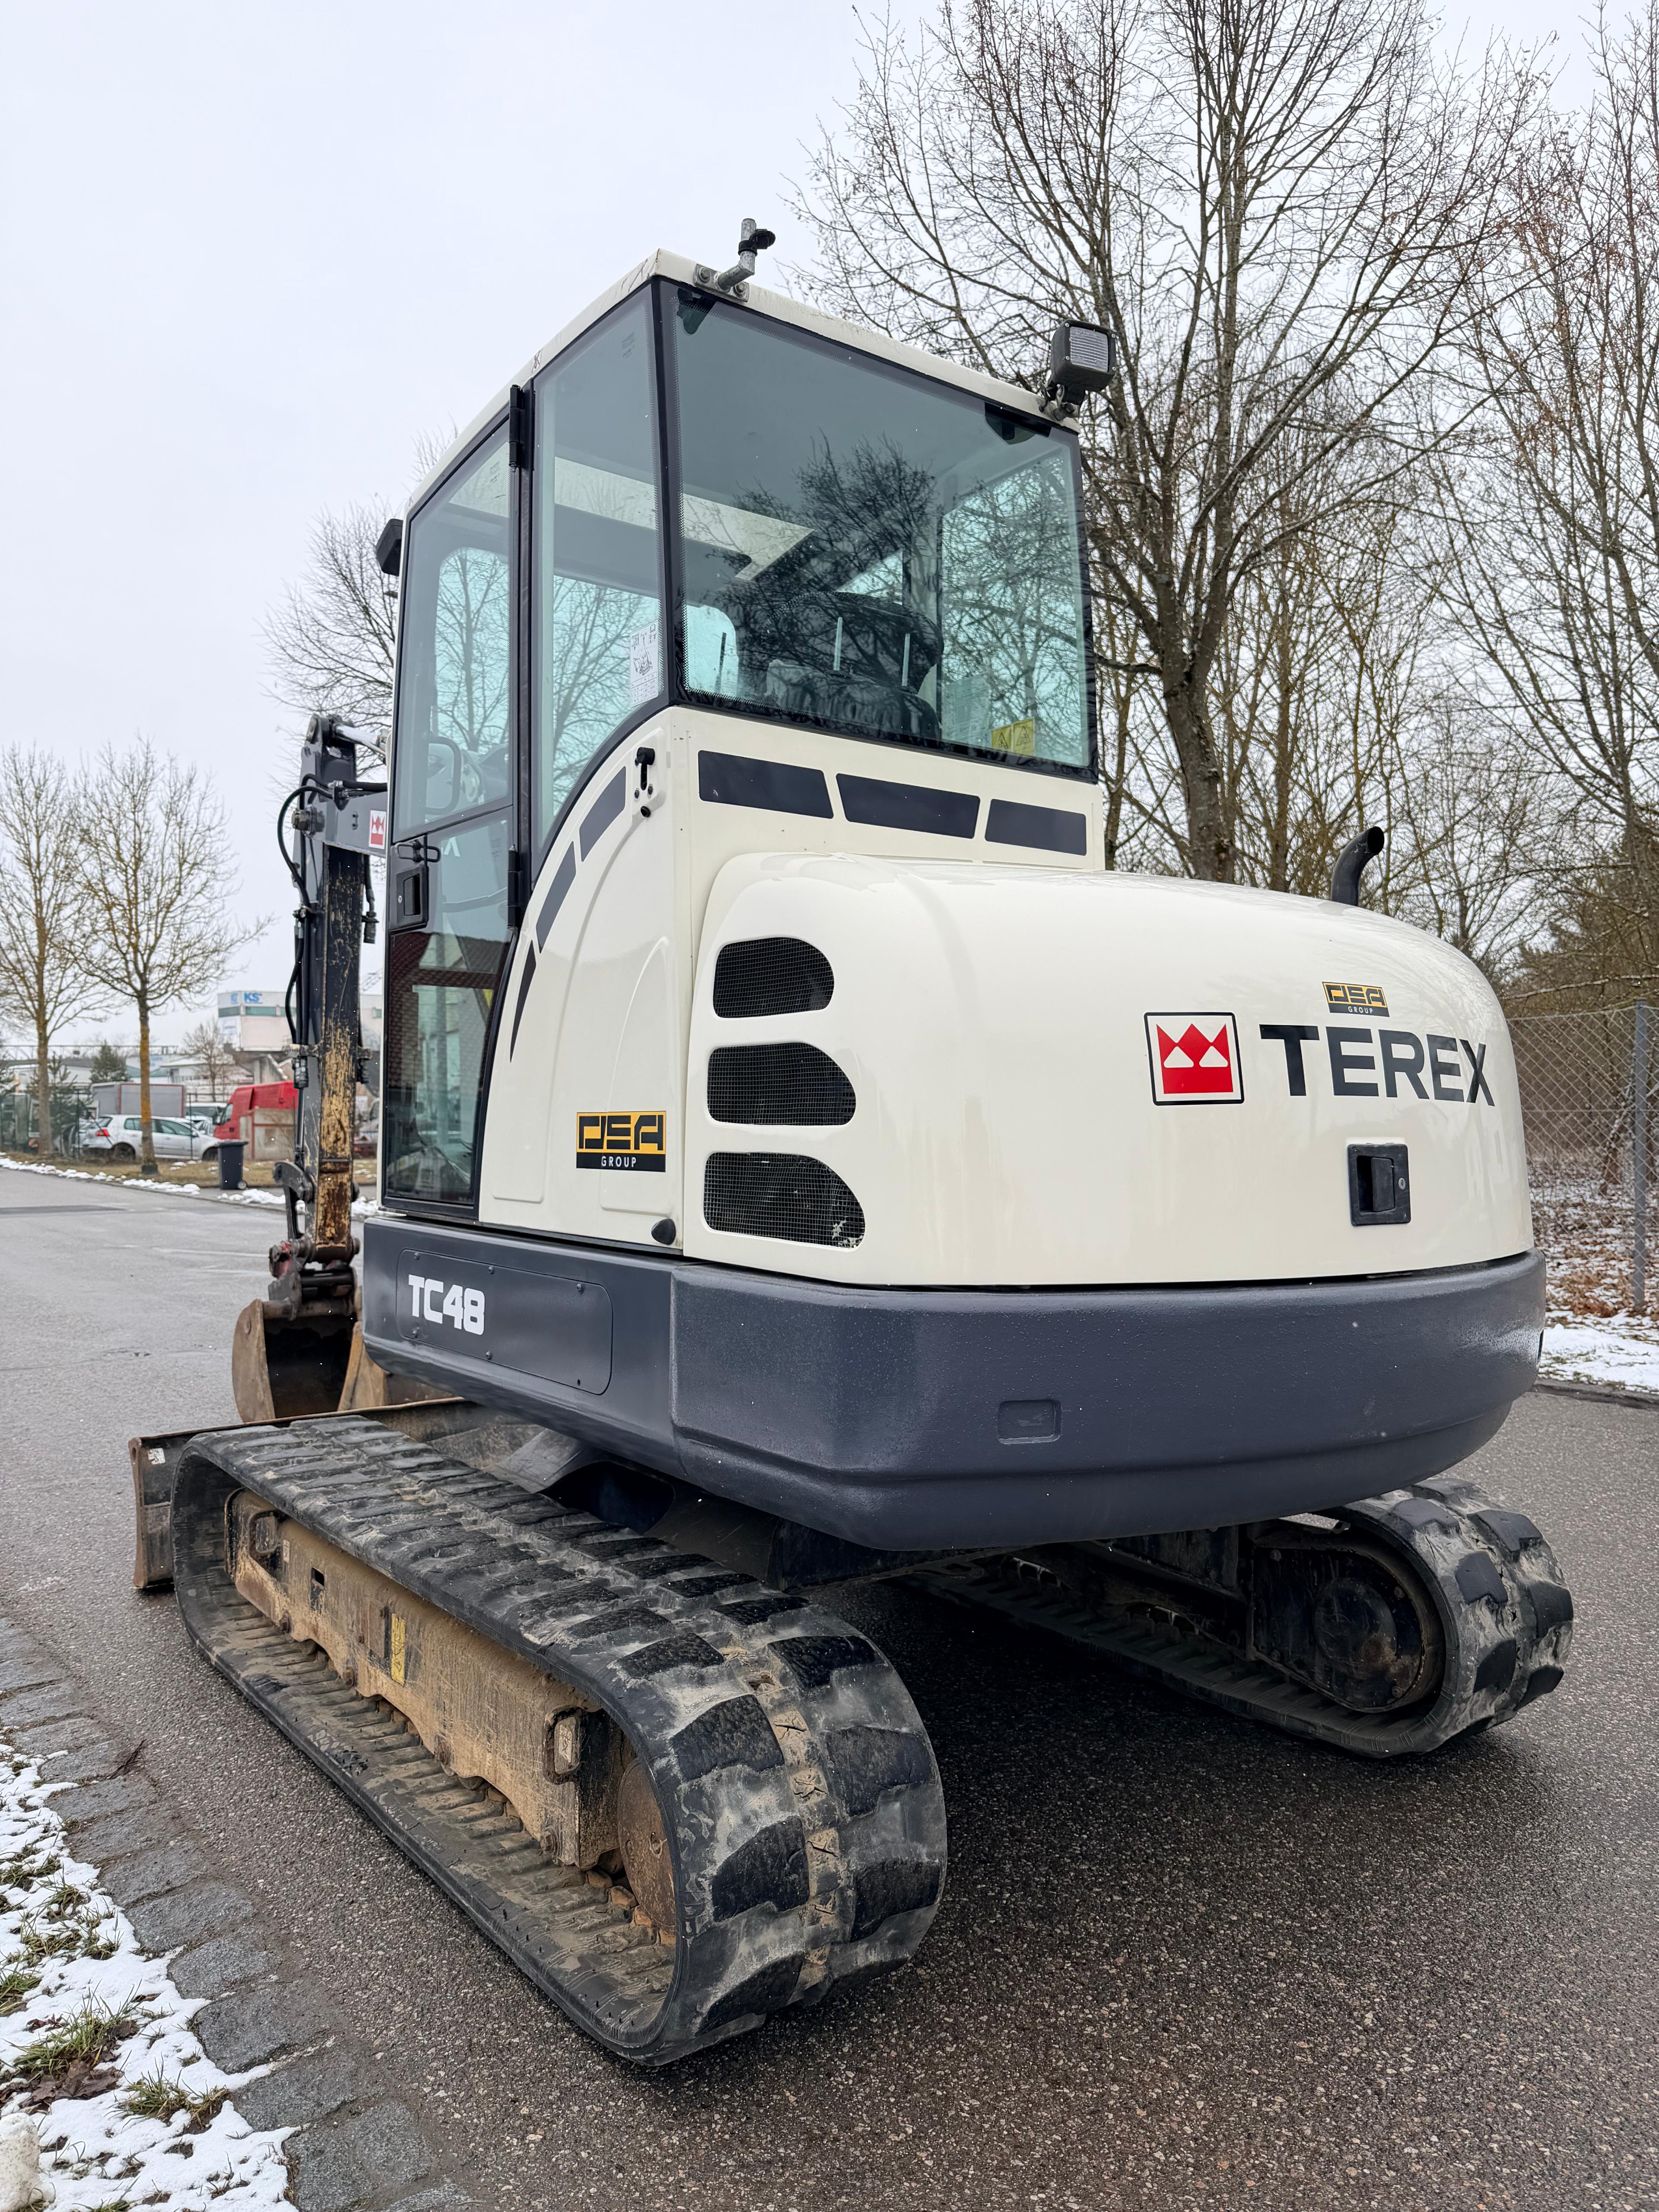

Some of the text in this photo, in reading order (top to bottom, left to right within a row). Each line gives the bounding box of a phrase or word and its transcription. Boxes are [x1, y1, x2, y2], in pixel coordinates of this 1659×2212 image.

[1348, 1006, 1373, 1014] GROUP
[1259, 1023, 1496, 1107] TEREX
[601, 1155, 637, 1168] GROUP
[408, 1274, 485, 1335] TC48
